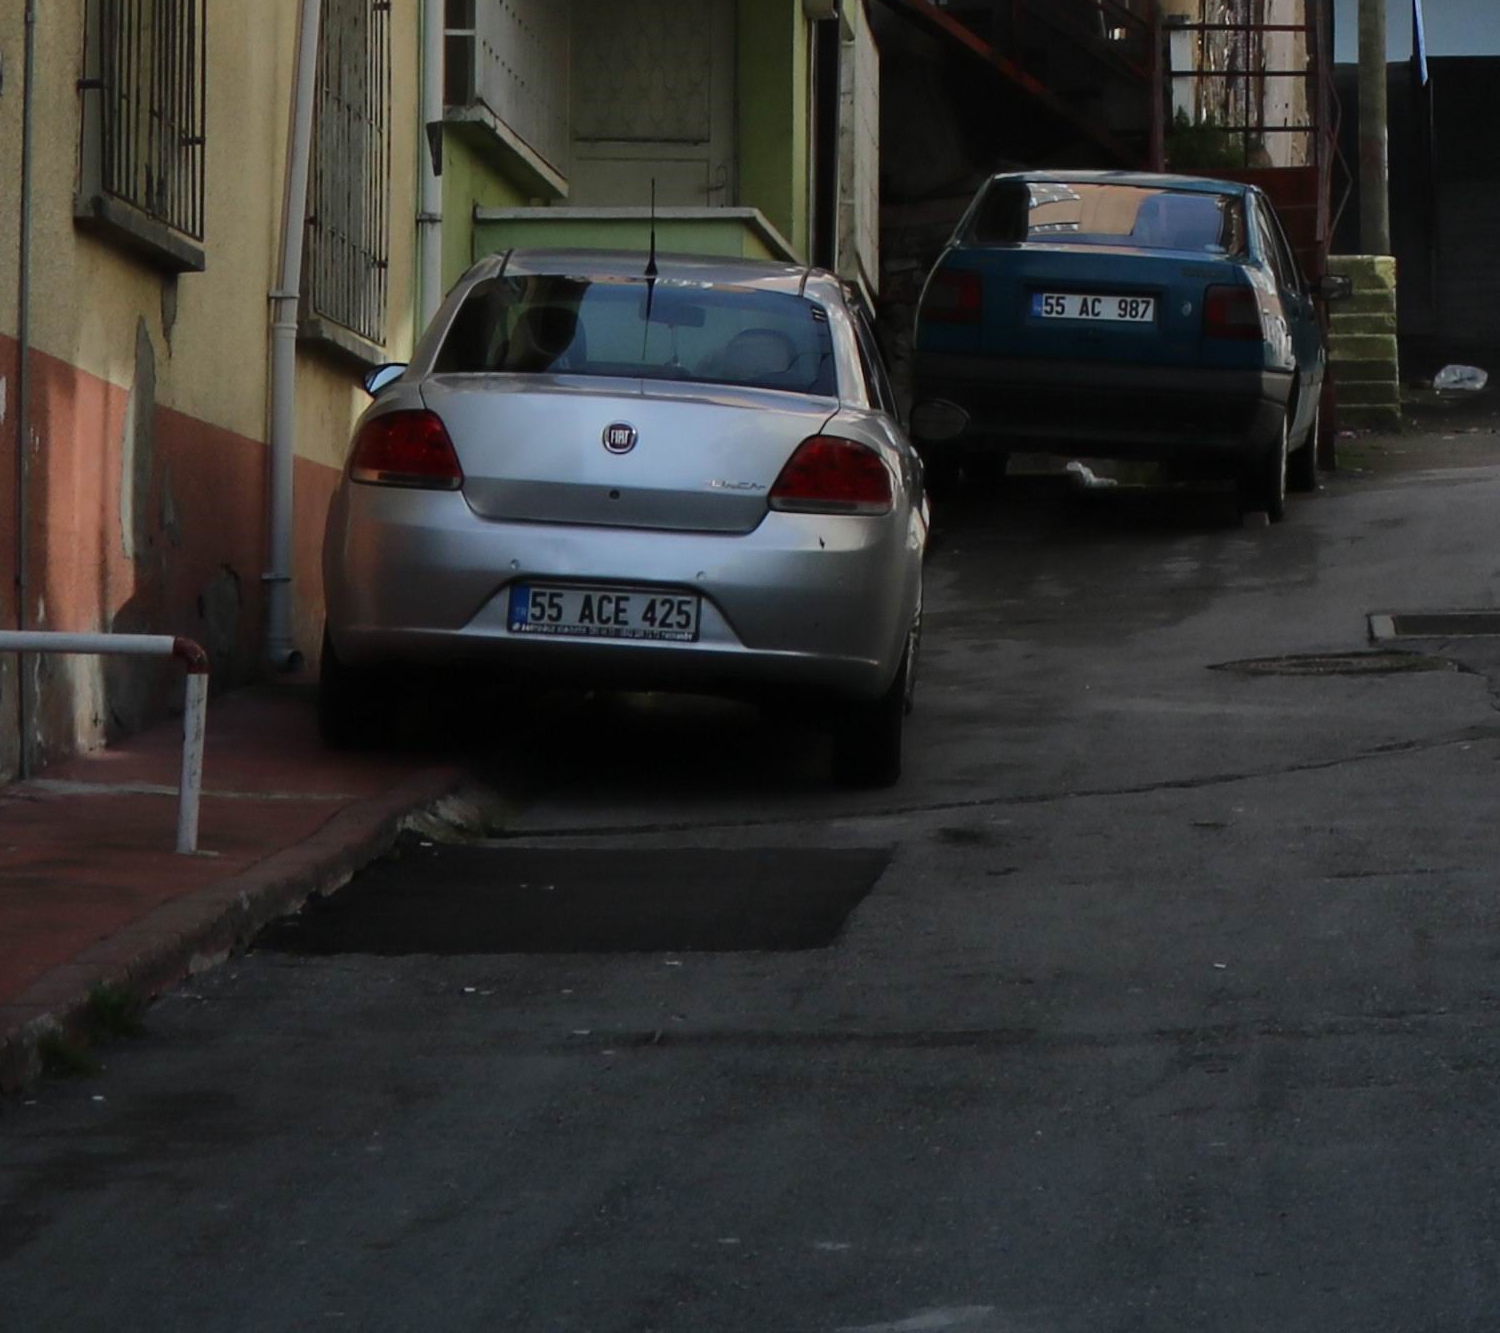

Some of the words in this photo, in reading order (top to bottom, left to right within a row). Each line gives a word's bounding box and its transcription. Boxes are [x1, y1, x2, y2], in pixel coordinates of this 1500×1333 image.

[1043, 295, 1066, 315] 55
[1078, 298, 1102, 317] AC
[1117, 299, 1151, 319] 987
[610, 429, 630, 445] FIAT
[530, 590, 564, 622] 55
[578, 594, 630, 626] ACE
[642, 598, 692, 630] 425
